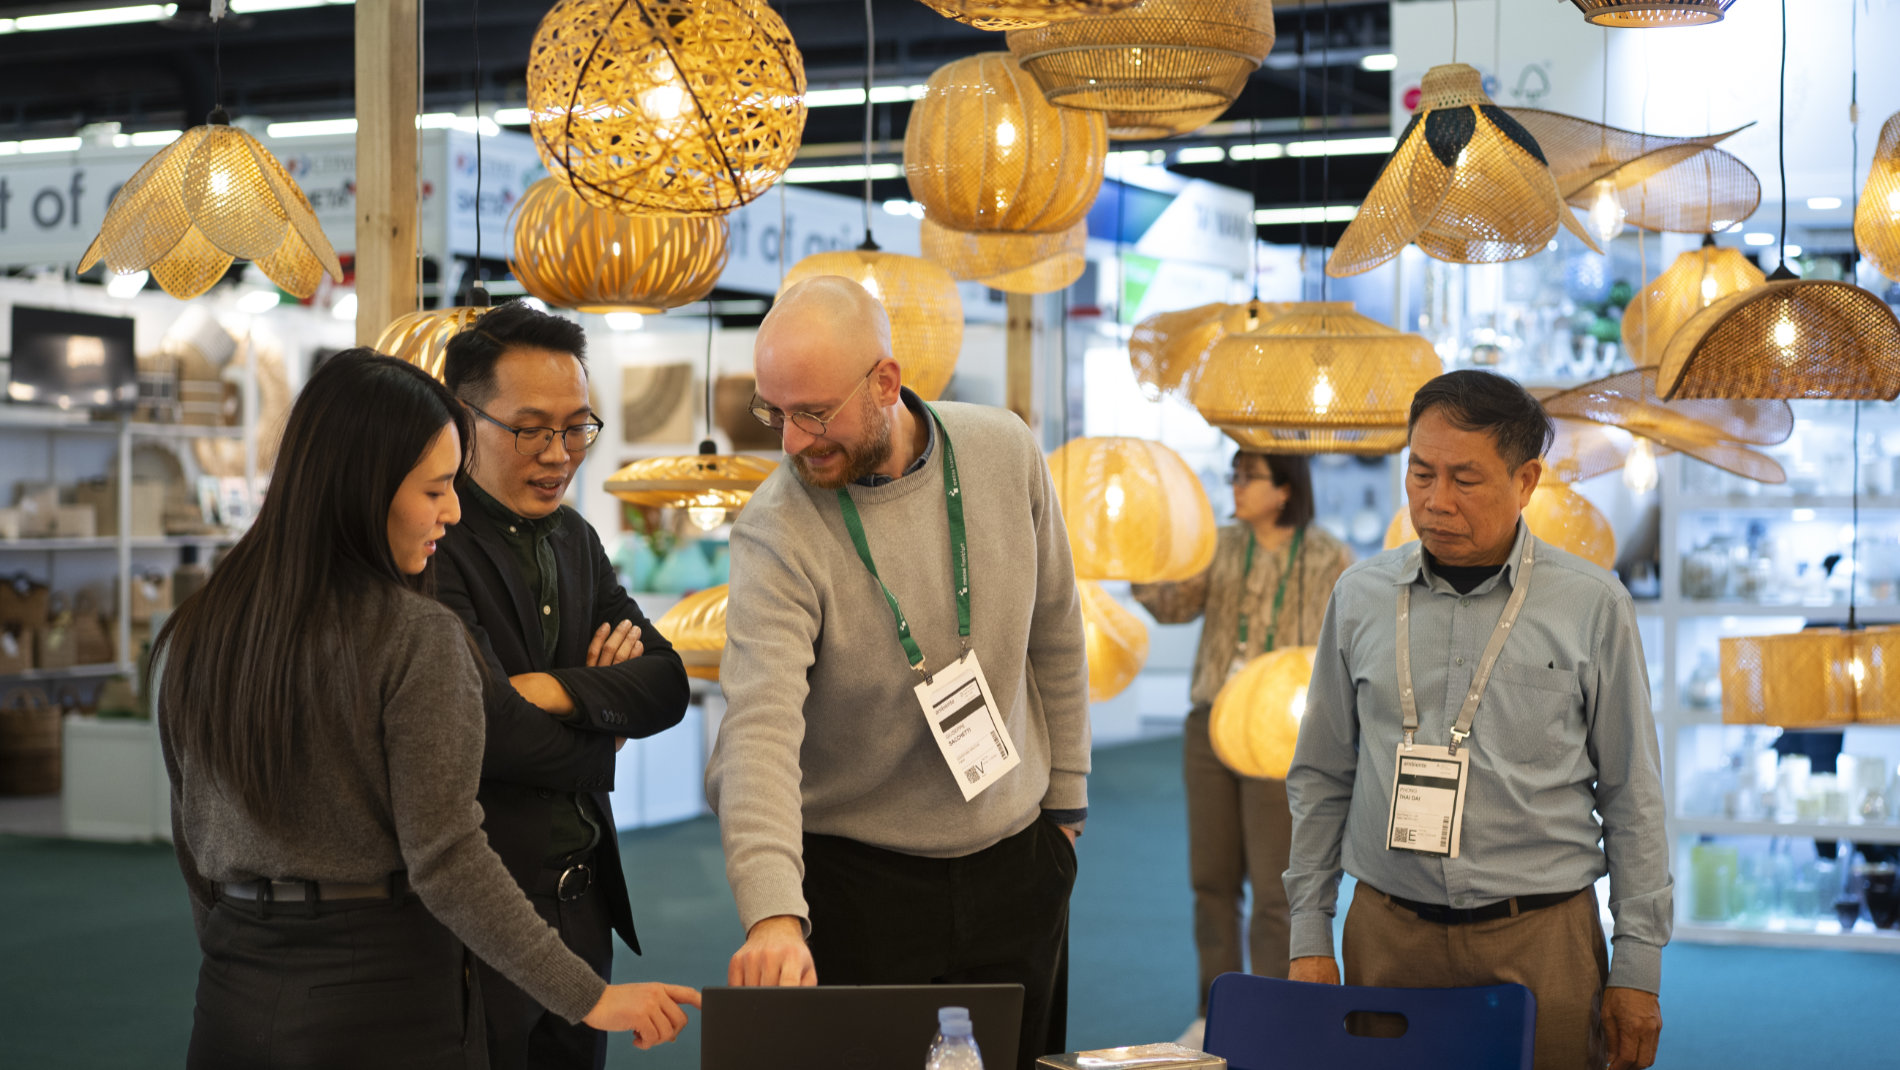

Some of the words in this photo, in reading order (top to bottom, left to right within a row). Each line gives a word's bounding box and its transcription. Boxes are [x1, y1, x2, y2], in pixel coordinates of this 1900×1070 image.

[32, 169, 85, 229] of
[975, 761, 985, 775] V
[1408, 829, 1417, 842] E
